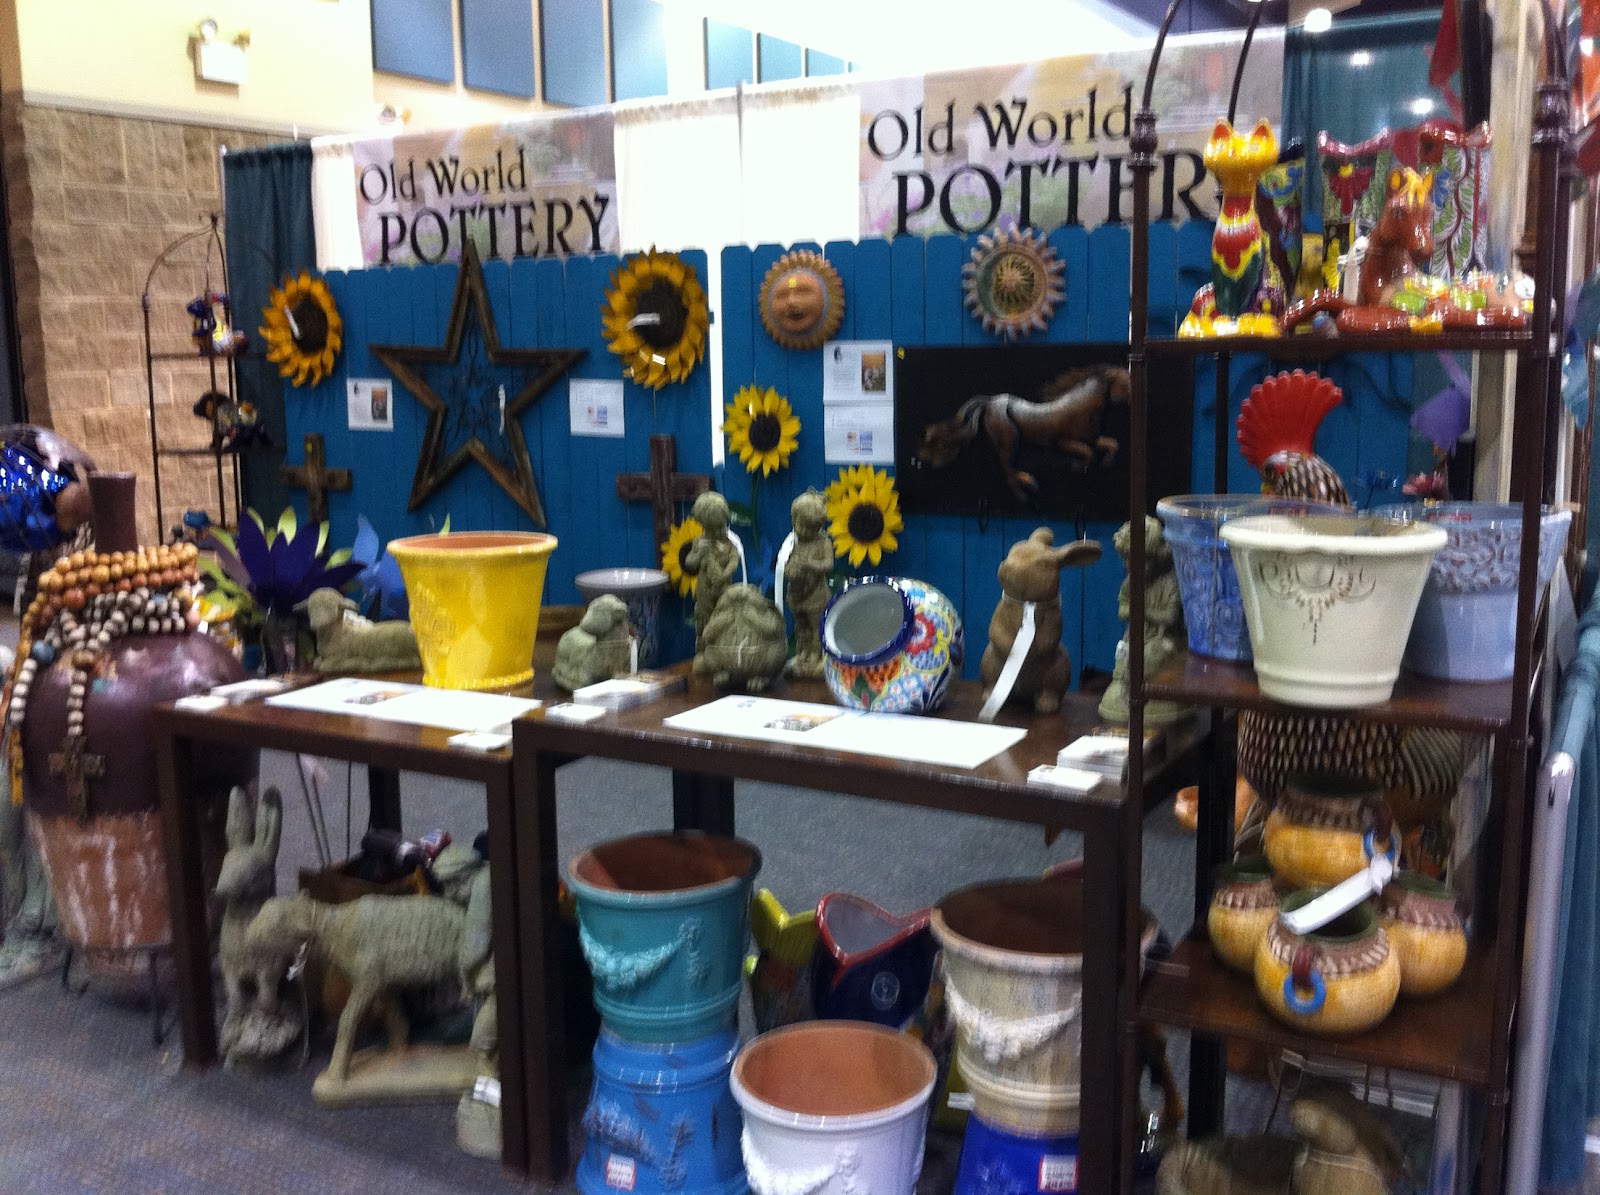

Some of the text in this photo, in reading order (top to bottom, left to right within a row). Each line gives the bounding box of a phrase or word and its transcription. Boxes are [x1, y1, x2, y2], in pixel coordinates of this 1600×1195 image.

[868, 81, 1134, 162] Old World
[359, 145, 527, 205] Old World
[892, 148, 1222, 237] POTTER
[378, 191, 610, 266] POTTERY
